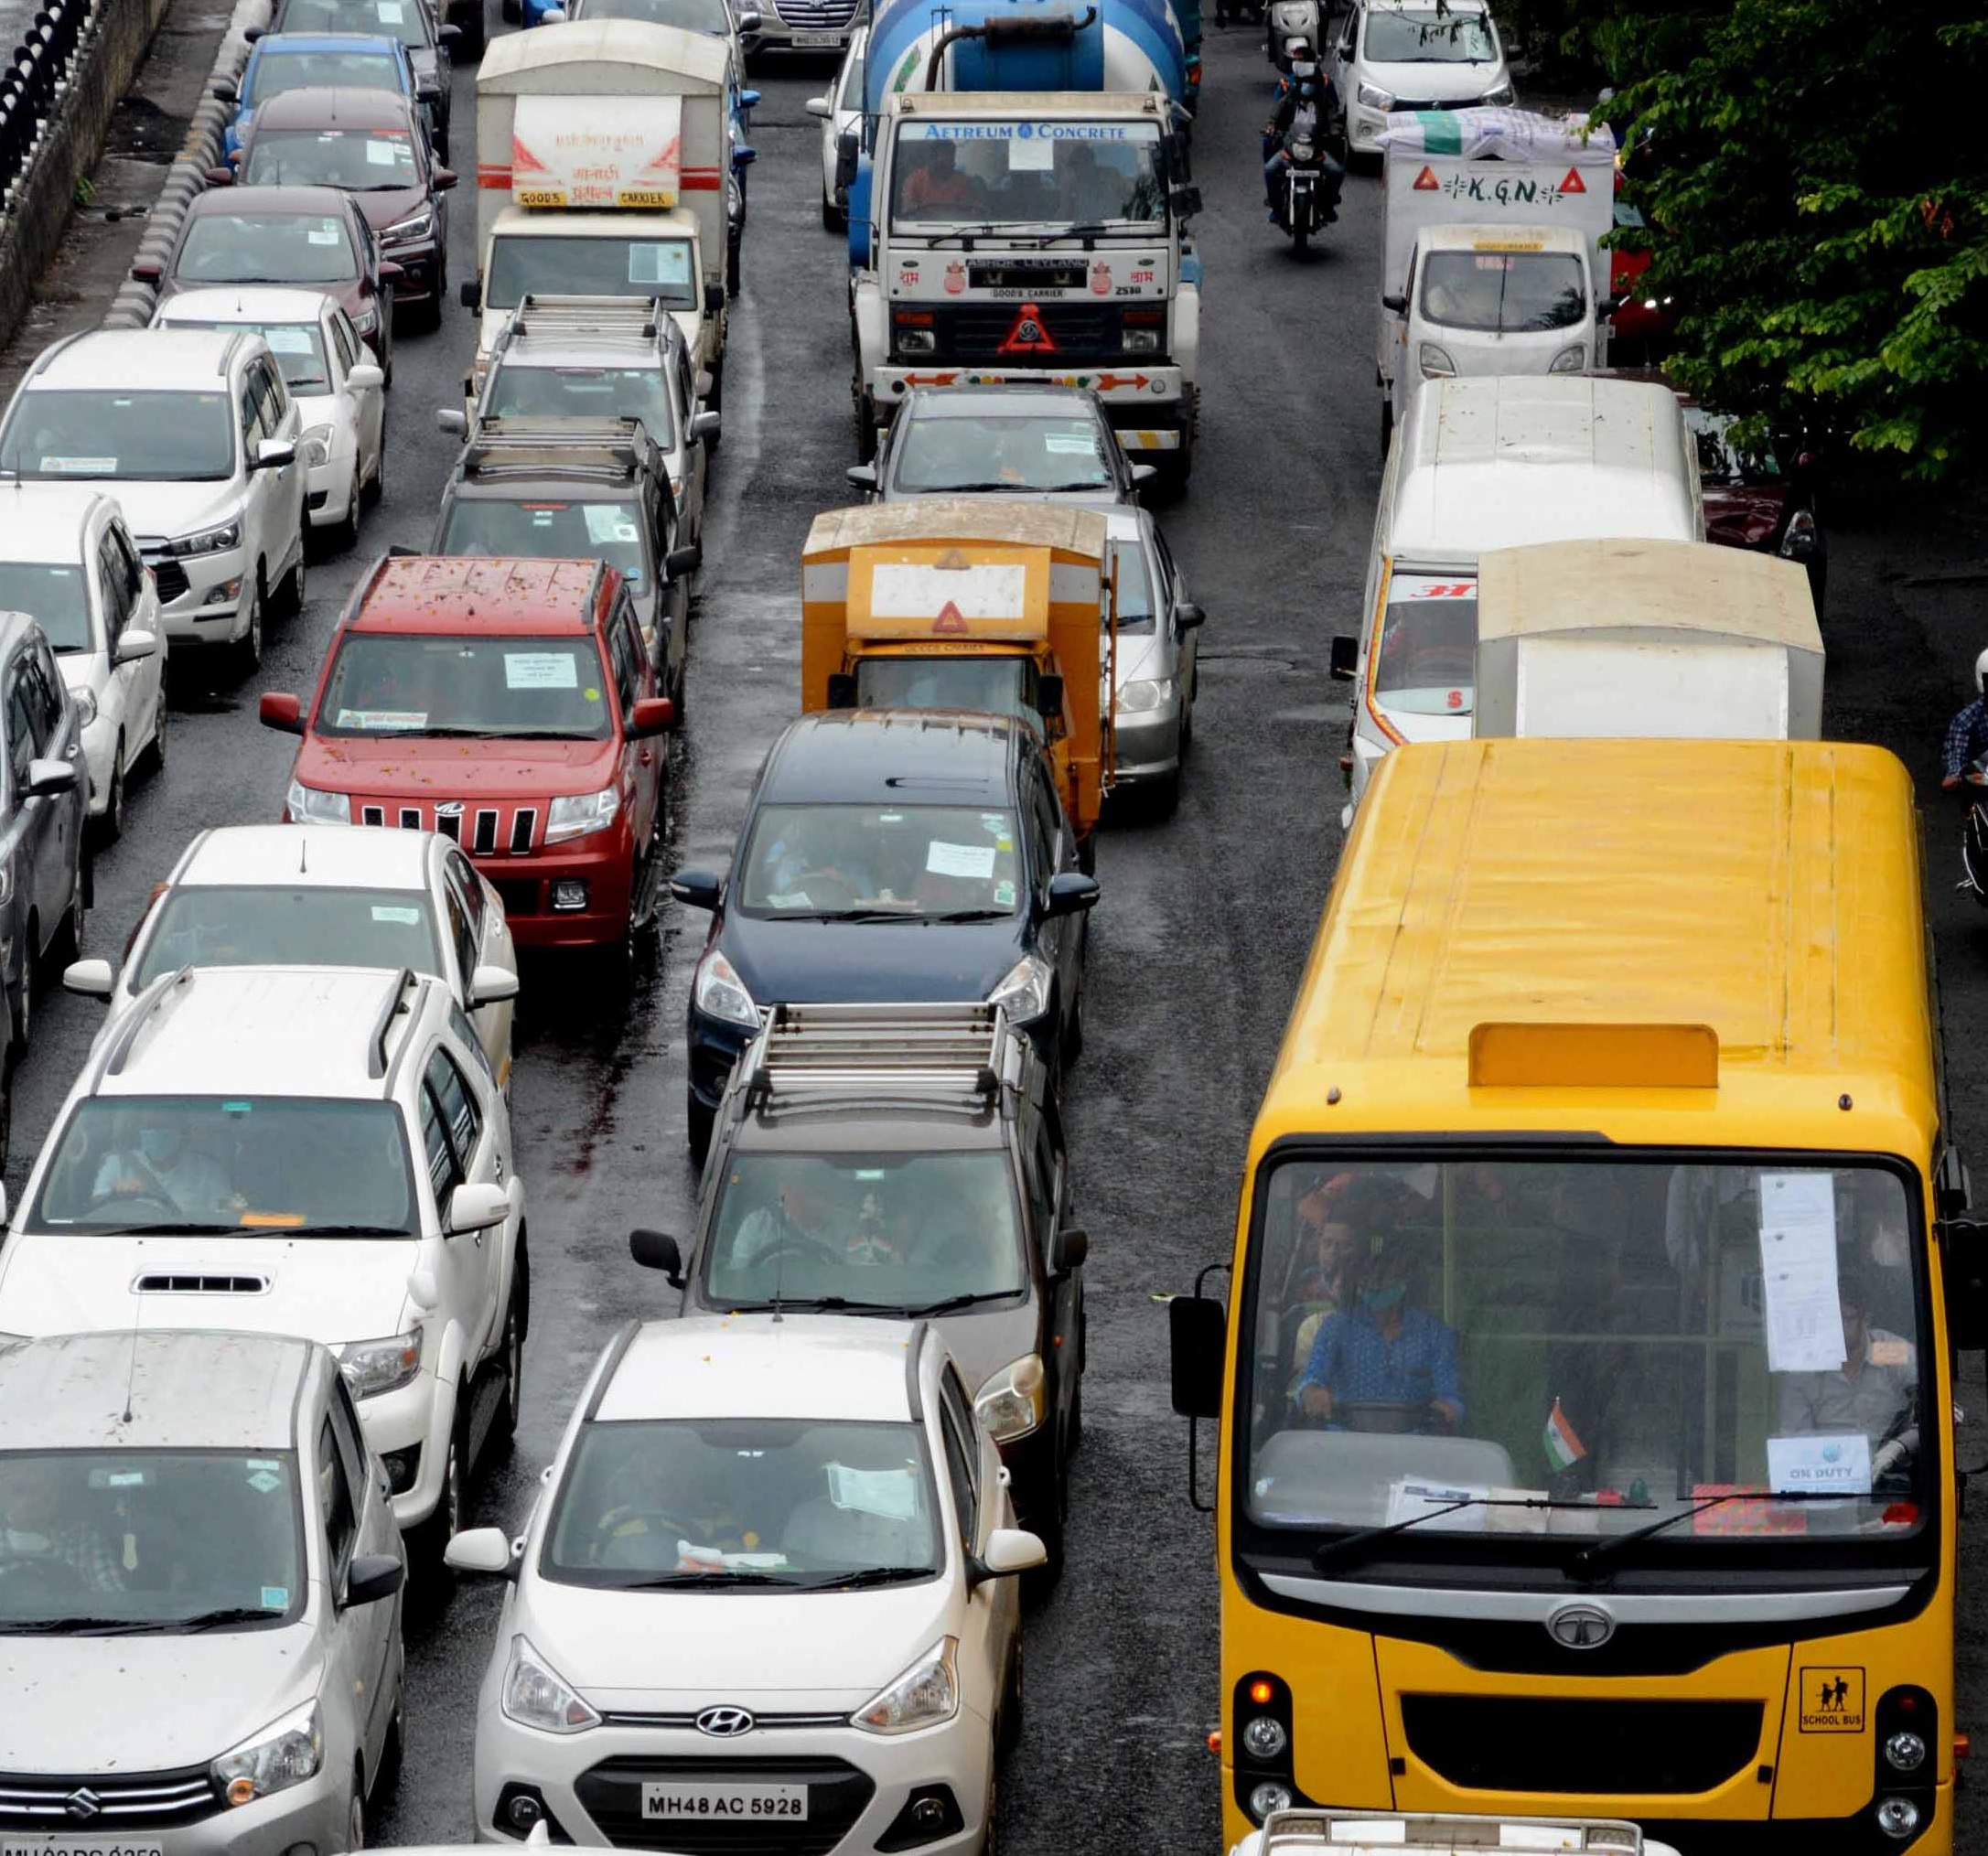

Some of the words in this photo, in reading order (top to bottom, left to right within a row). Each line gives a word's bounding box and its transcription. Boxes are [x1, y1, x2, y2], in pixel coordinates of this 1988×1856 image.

[926, 125, 1012, 138] AETREUM
[1038, 124, 1125, 139] CONCRETE
[521, 193, 561, 204] GOODS
[621, 192, 665, 204] CARRIER
[1802, 1715, 1841, 1725] SCHOOL
[1843, 1715, 1862, 1725] BUS
[649, 1797, 710, 1814] MH48
[714, 1797, 744, 1814] AC
[750, 1798, 802, 1815] 5928
